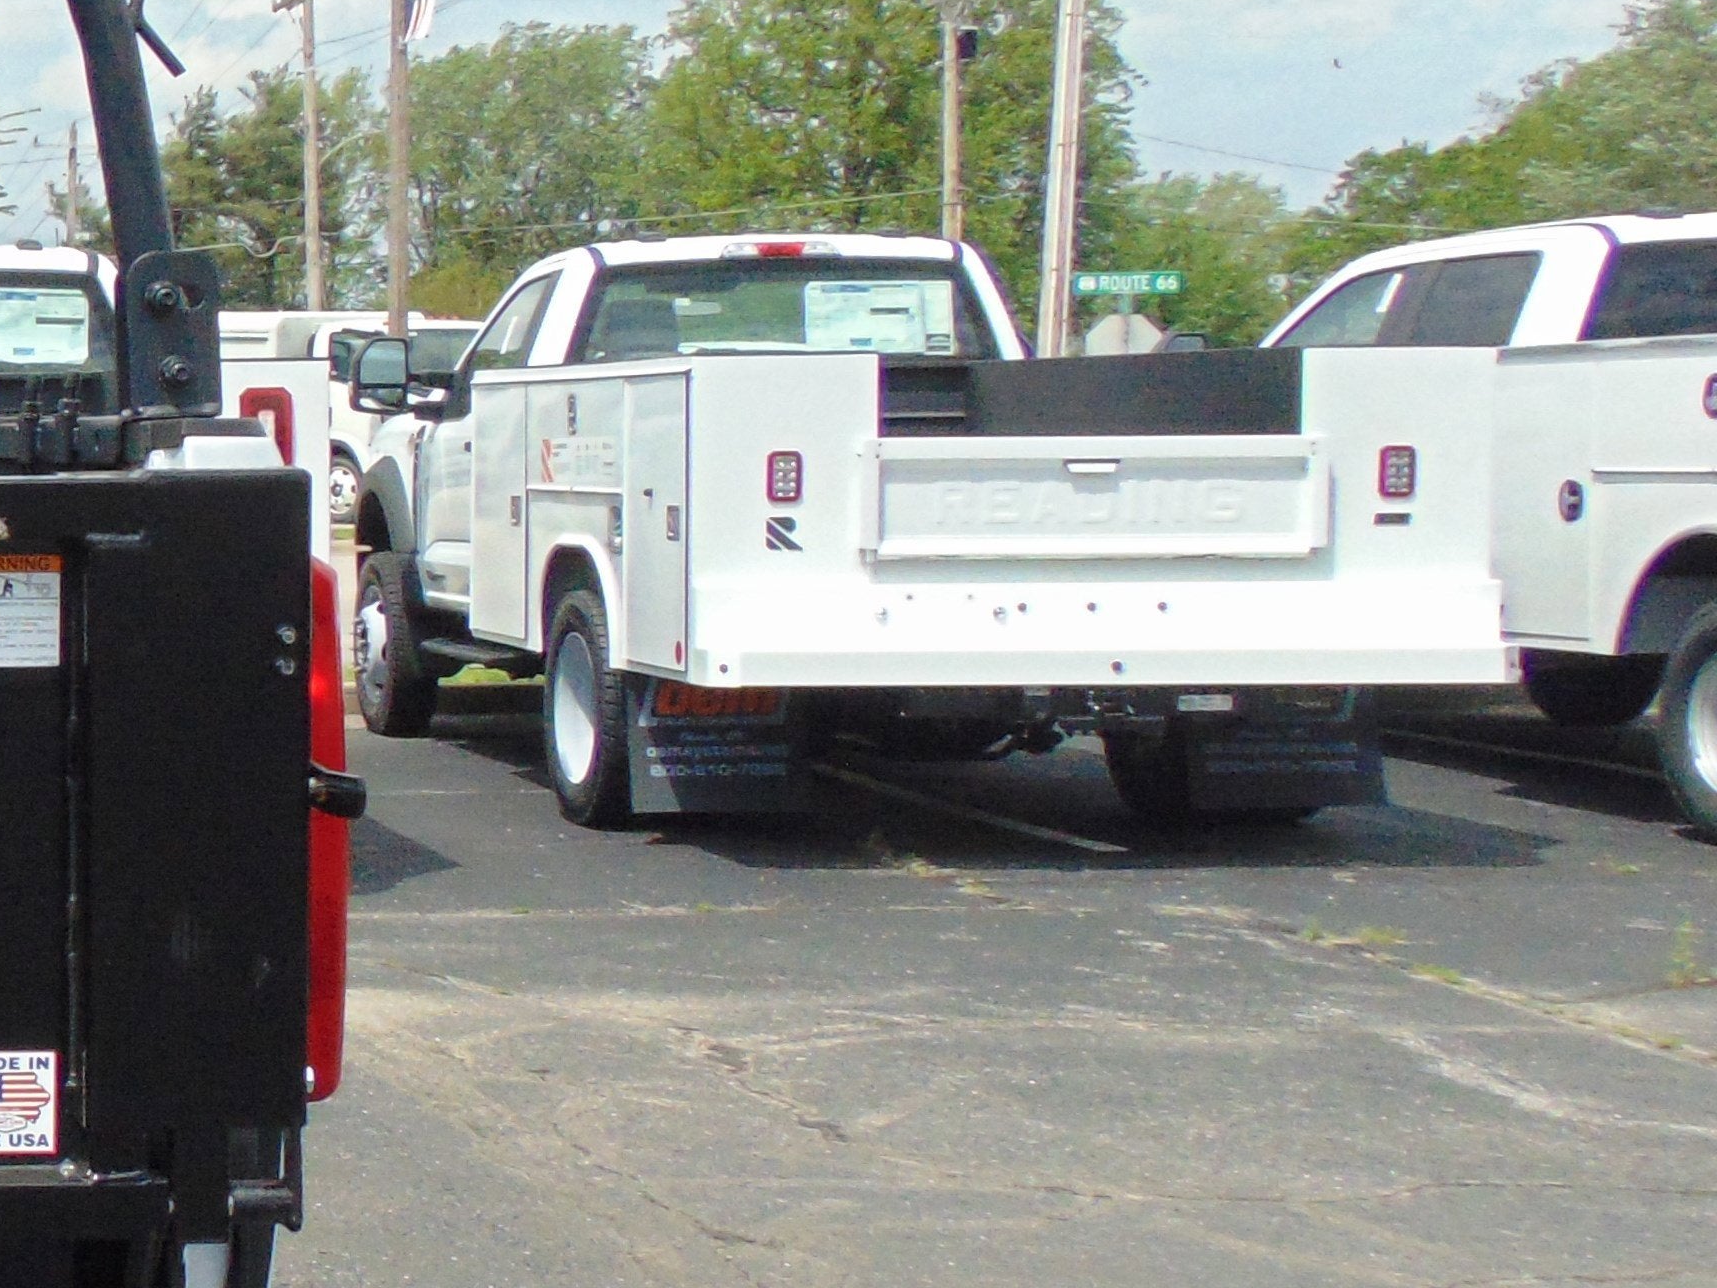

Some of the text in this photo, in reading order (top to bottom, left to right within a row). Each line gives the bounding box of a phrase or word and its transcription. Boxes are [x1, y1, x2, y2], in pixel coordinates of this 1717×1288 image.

[1098, 275, 1150, 290] ROUTE
[1156, 275, 1178, 290] 66
[28, 1057, 50, 1070] IN
[8, 1134, 50, 1147] USA
